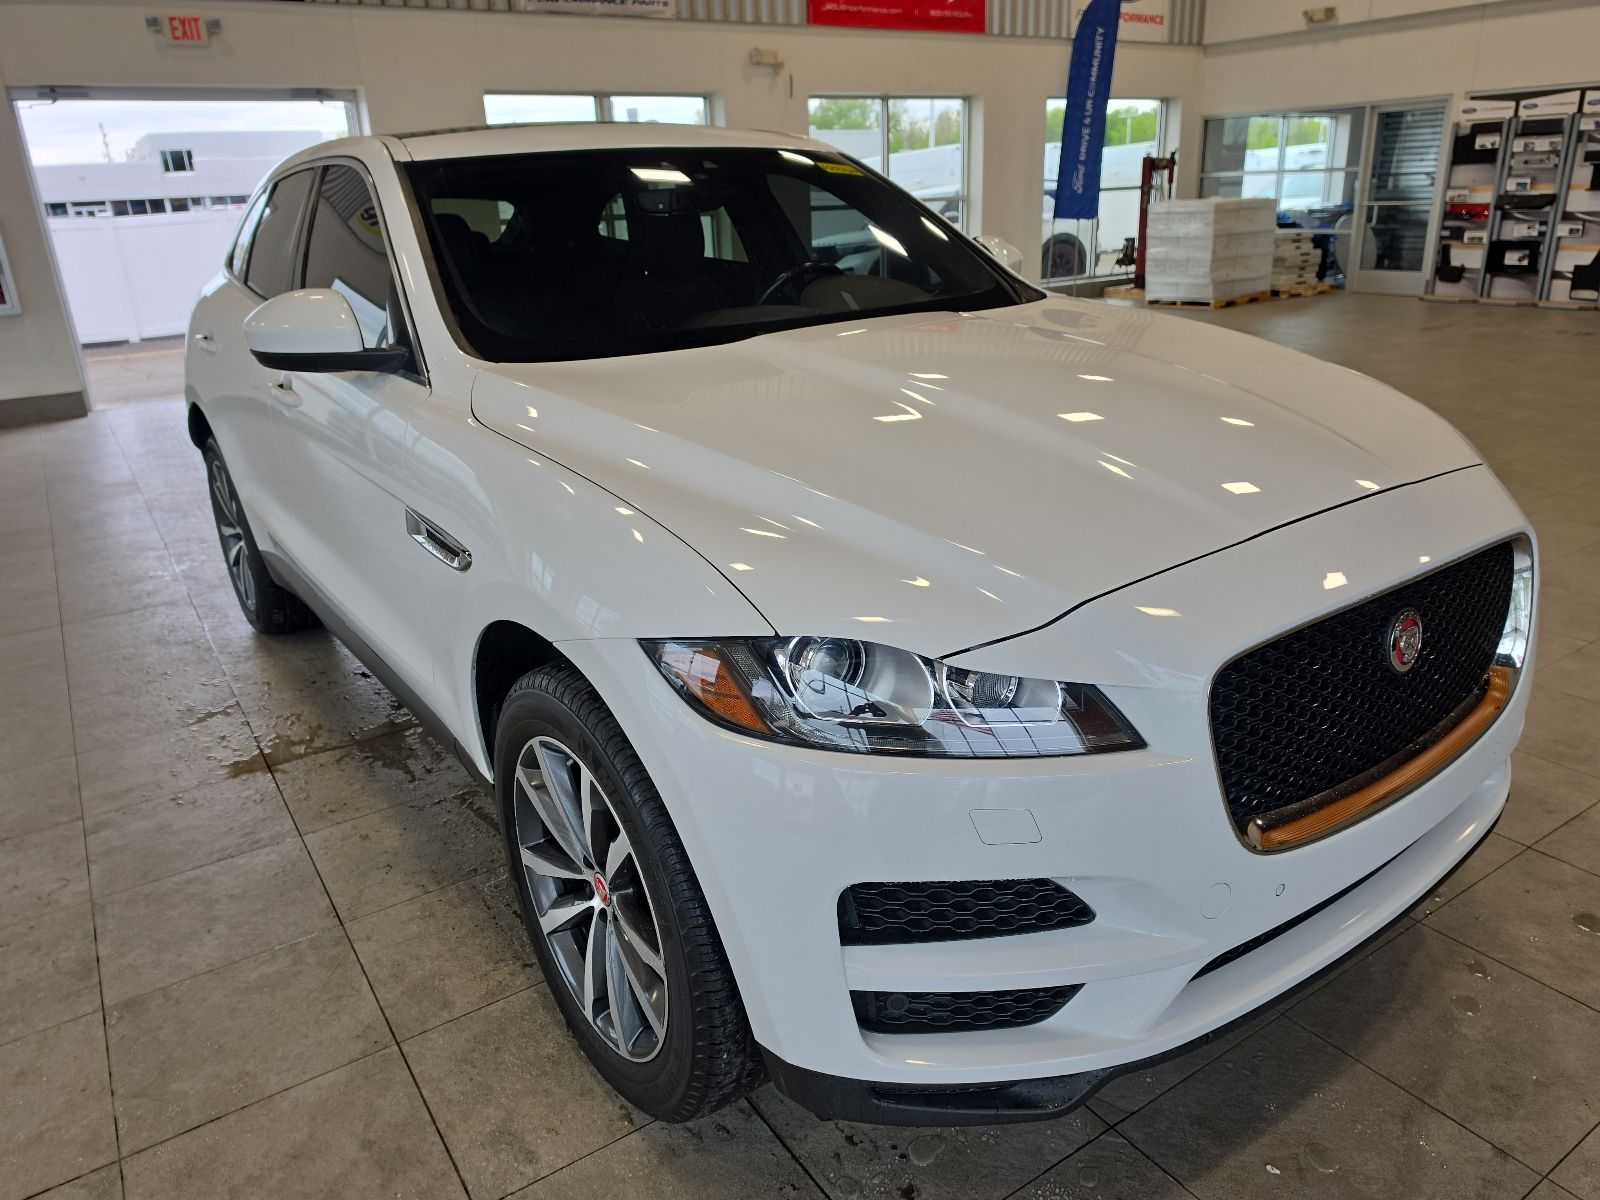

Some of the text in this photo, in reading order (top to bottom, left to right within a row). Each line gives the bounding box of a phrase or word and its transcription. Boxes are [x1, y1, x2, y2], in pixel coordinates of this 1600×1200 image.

[168, 16, 202, 41] EXIT
[1119, 11, 1165, 25] FORMANCE
[1084, 99, 1094, 116] UR
[1079, 127, 1091, 161] DRIVE
